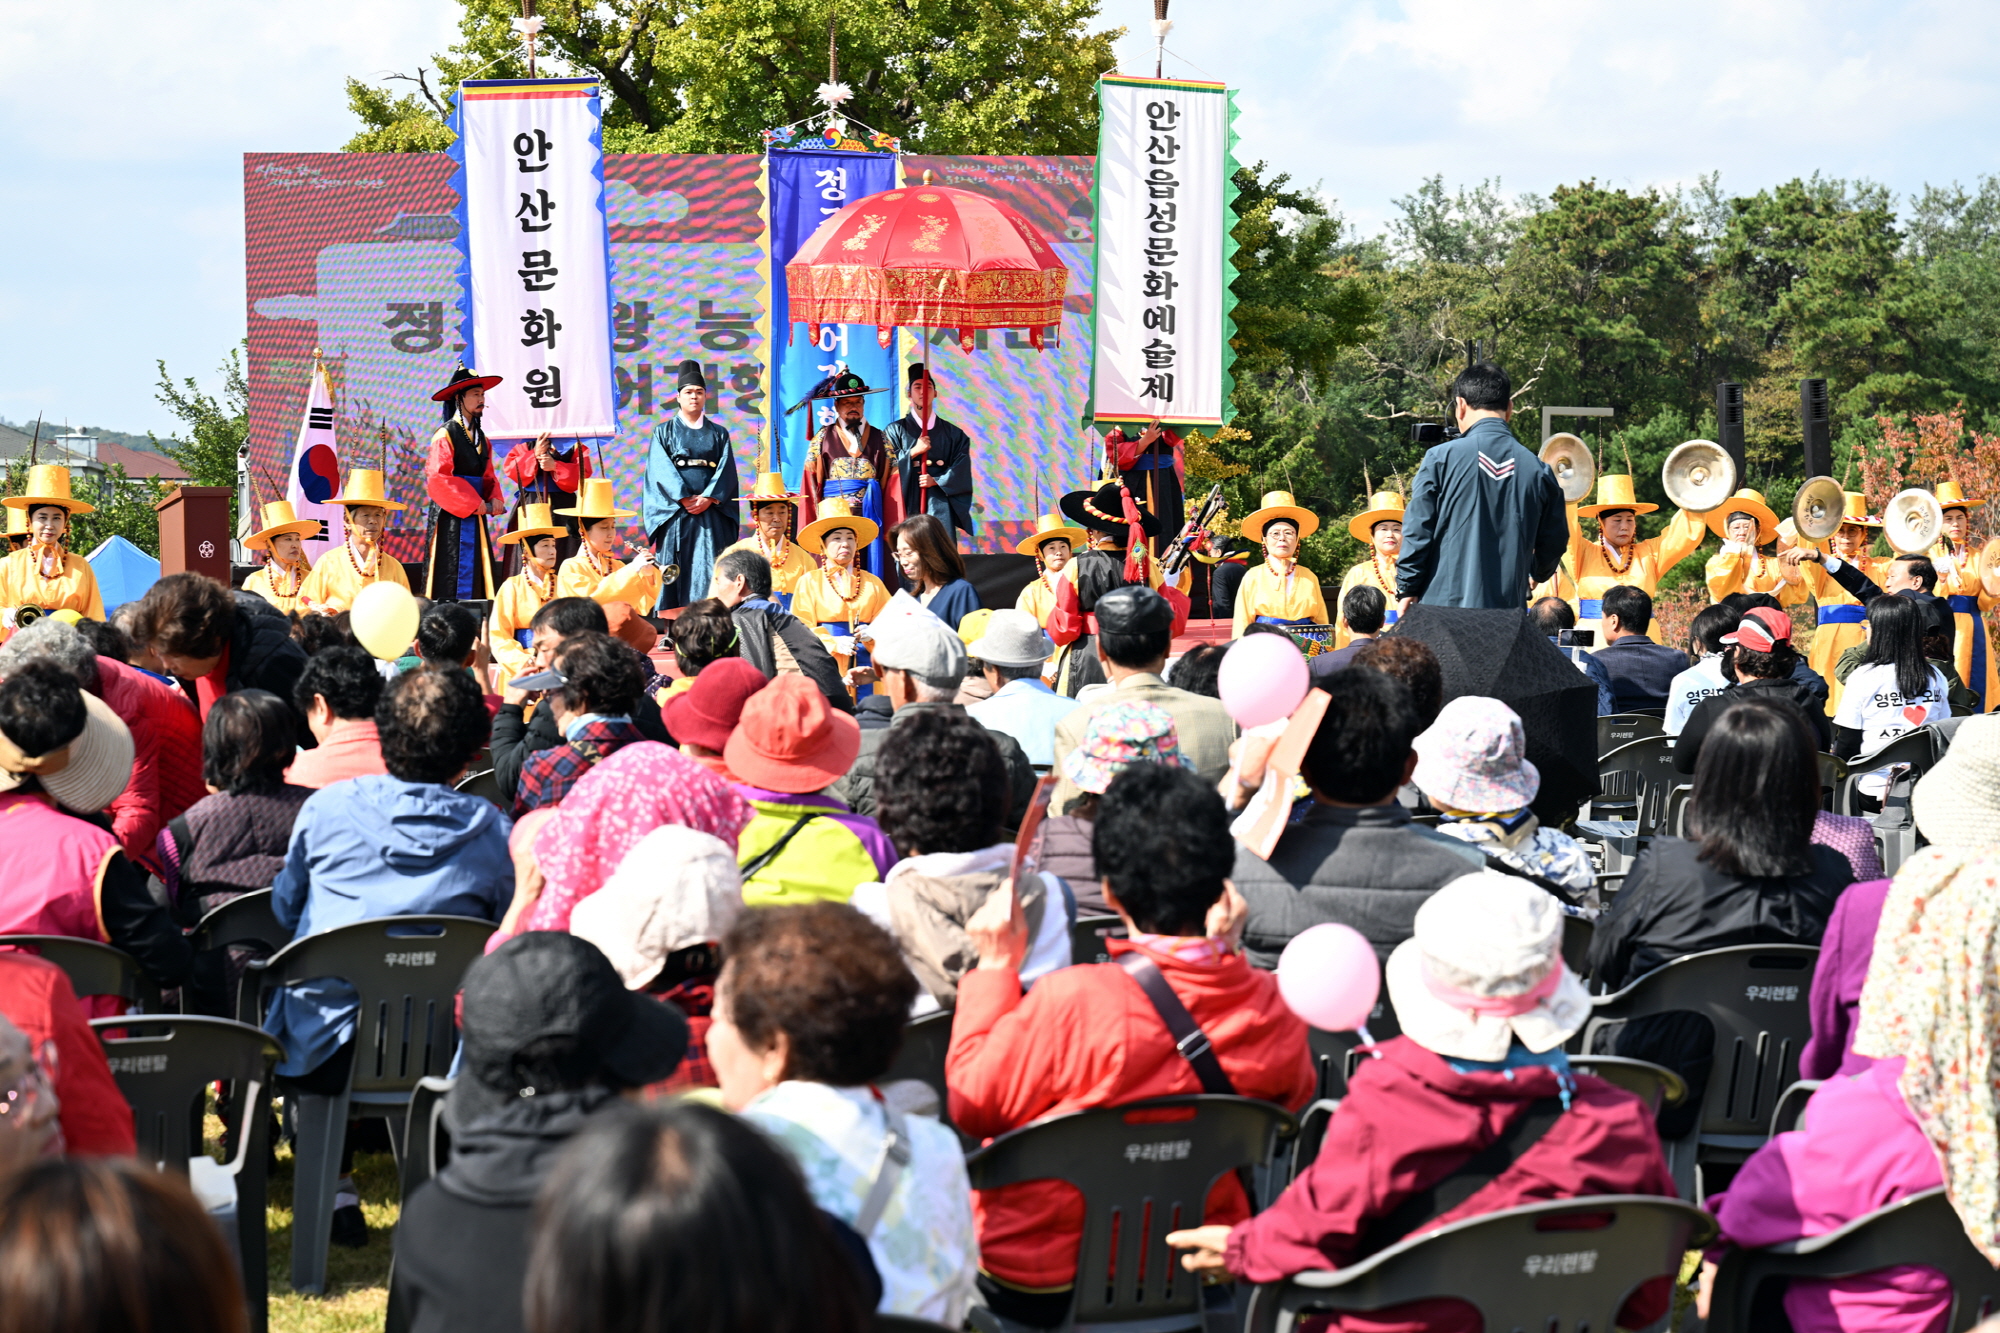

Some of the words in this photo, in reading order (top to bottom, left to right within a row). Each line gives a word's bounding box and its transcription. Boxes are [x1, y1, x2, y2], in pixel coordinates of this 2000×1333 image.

[1139, 100, 1181, 403] 안산읍성문화예술제
[513, 128, 563, 408] 안산문화원
[384, 951, 437, 967] 우리렌탈
[1745, 985, 1799, 1001] 우리렌탈
[1124, 1139, 1192, 1164] 우리렌탈
[1522, 1249, 1598, 1278] 우리렌탈
